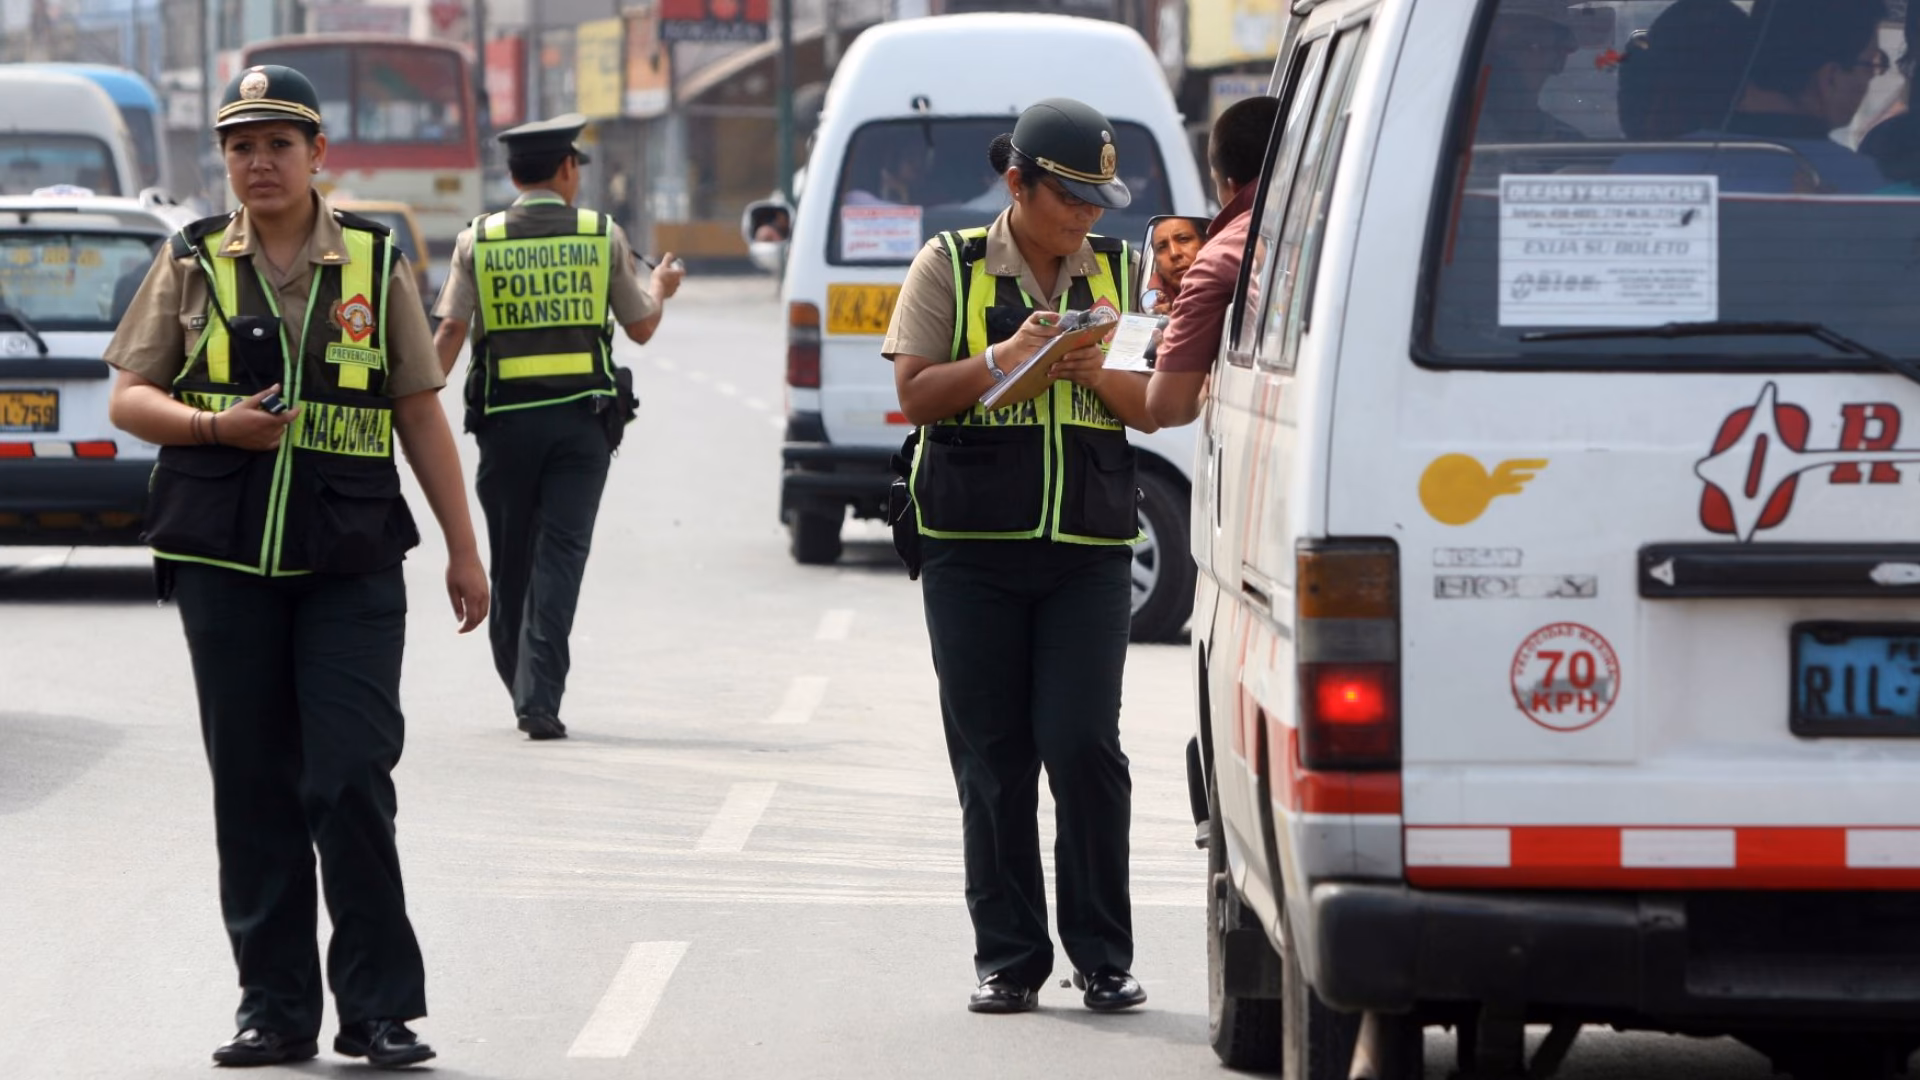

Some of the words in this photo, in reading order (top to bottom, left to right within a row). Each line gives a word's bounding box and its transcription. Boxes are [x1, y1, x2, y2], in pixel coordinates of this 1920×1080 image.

[484, 243, 599, 273] ALCOHOLEMIA
[491, 270, 593, 299] POLICIA
[491, 297, 594, 326] TRANSITO
[301, 401, 385, 454] NACIONAL
[1536, 649, 1597, 690] 70
[1531, 691, 1599, 714] KPH
